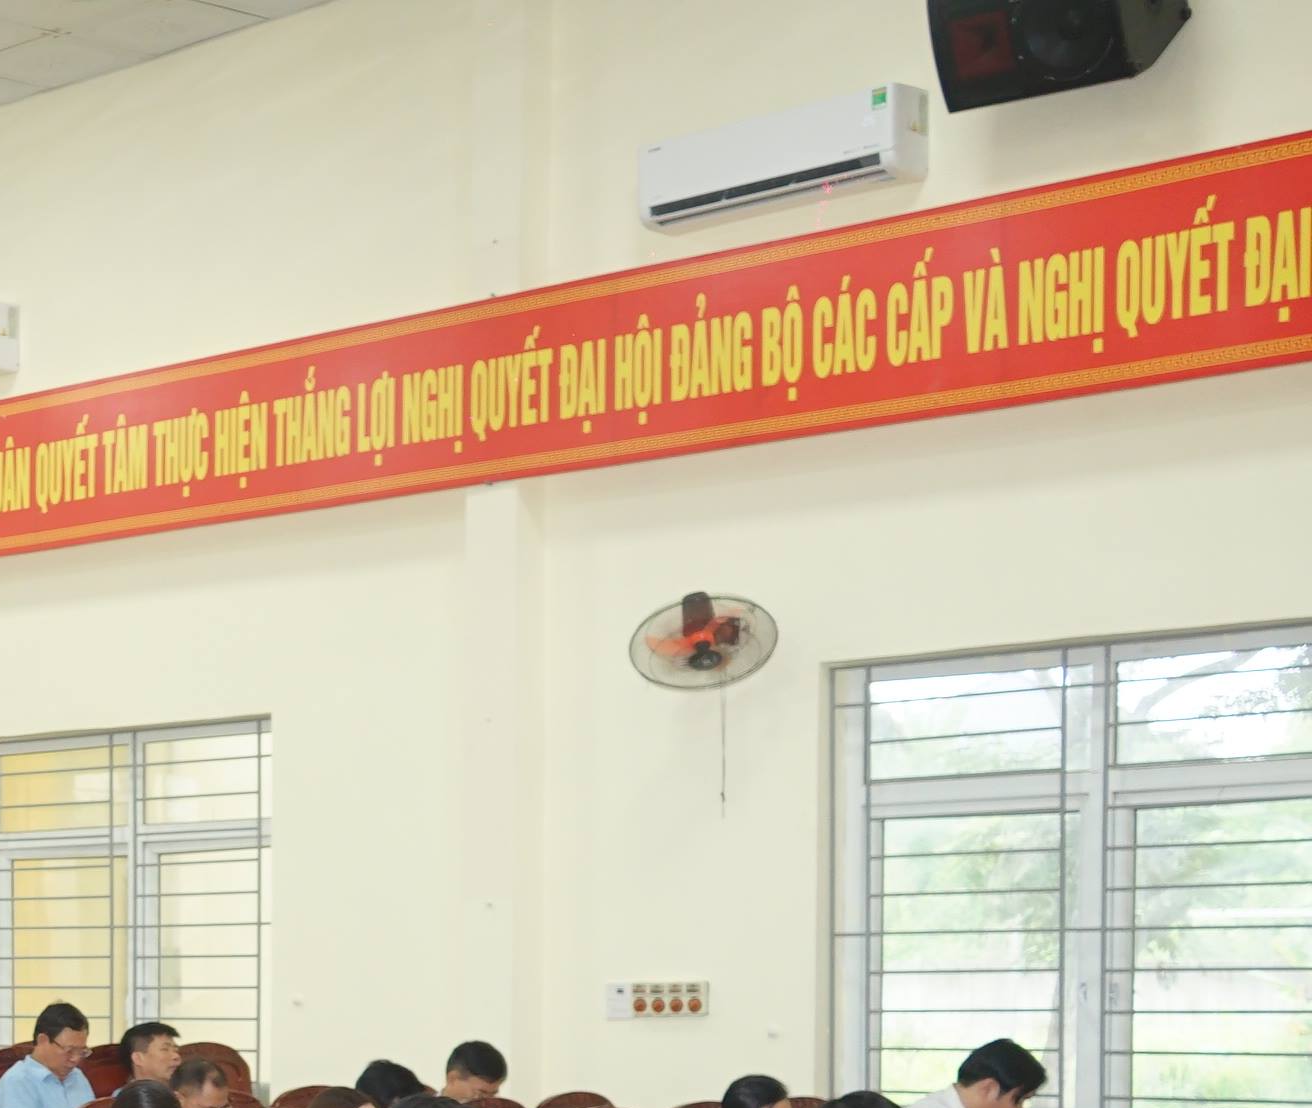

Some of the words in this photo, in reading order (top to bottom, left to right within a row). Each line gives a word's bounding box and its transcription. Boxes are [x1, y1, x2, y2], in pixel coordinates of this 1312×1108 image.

[35, 413, 99, 514] QUYẾT
[101, 413, 149, 495] TÂM
[152, 407, 209, 497] THỰC
[214, 390, 268, 489] HIỆN
[273, 366, 351, 467] THẮNG
[357, 371, 396, 466] LỢI
[402, 364, 463, 453] NGHỊ
[470, 326, 553, 441] QUYẾT
[559, 338, 606, 433] ĐẠI
[614, 314, 662, 425] HỘI
[670, 293, 752, 401] ĐẢNG
[762, 285, 803, 401] BỘ
[812, 275, 877, 378] CÁC
[887, 247, 953, 366] CẤP
[963, 248, 1008, 353] VÀ
[1018, 246, 1104, 353] NGHỊ
[1116, 195, 1234, 337] QUYẾT
[1244, 207, 1312, 322] ĐẠI
